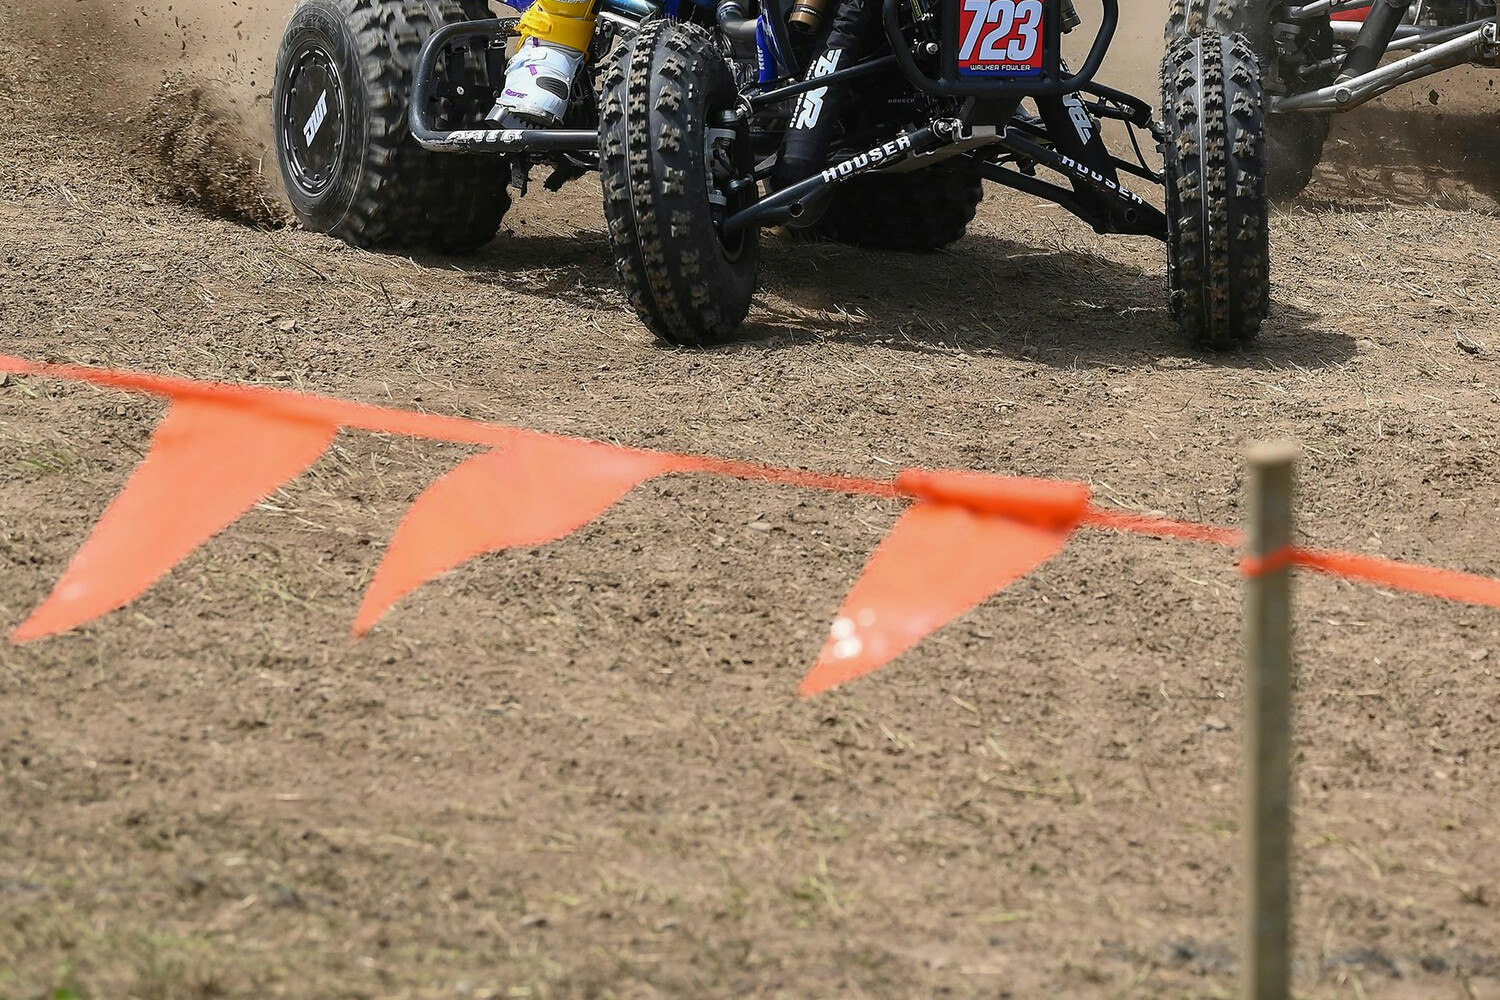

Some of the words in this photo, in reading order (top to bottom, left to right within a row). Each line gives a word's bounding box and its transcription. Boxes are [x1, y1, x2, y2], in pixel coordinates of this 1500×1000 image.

[959, 0, 1043, 62] 723
[1001, 64, 1031, 72] FOWLER
[821, 134, 912, 185] HOUSER
